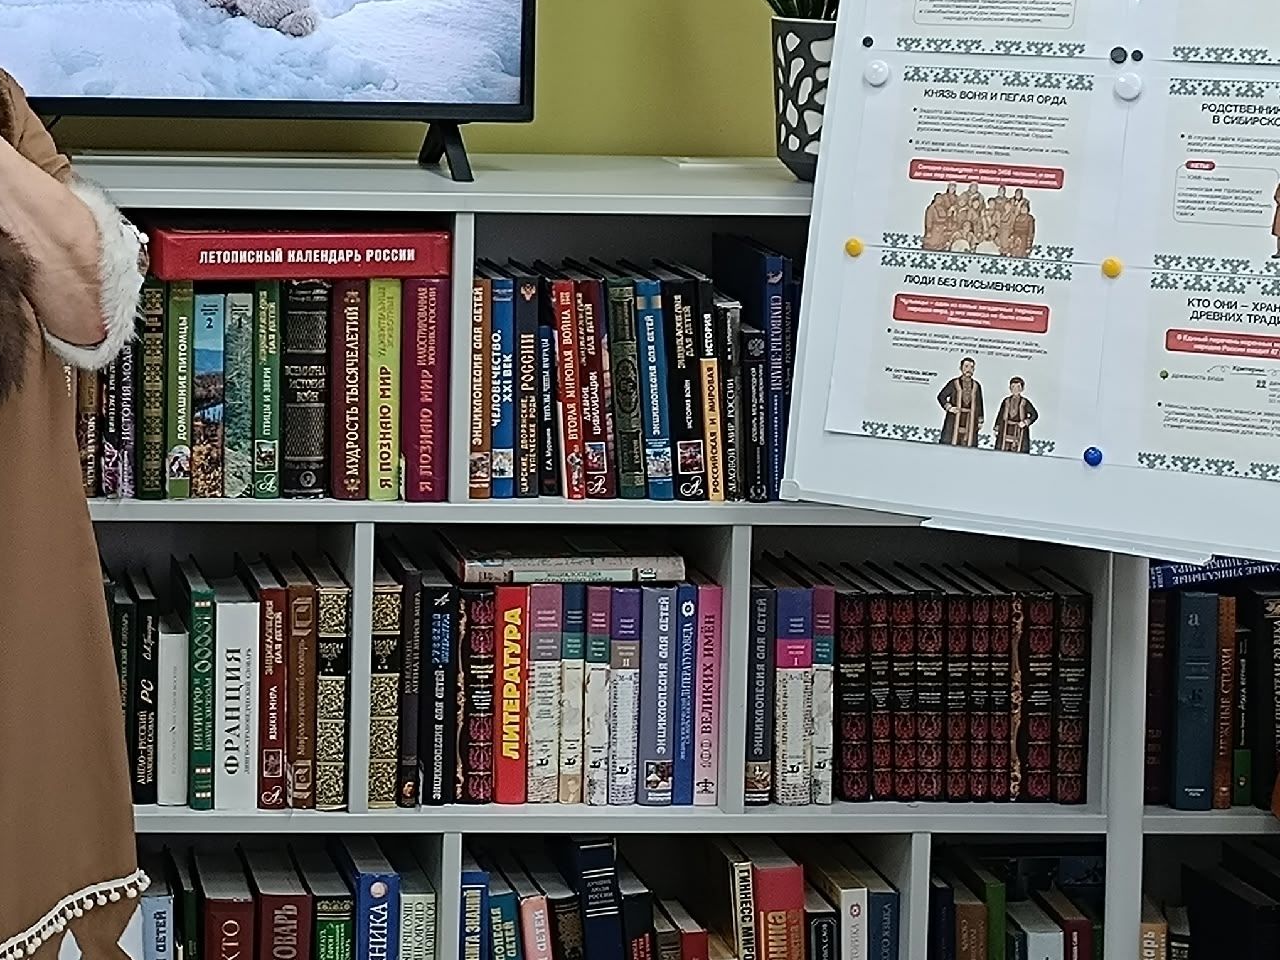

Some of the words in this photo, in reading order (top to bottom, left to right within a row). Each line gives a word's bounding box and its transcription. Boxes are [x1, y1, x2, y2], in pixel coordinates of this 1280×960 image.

[924, 89, 957, 99] КНЯЗЬ
[960, 92, 987, 100] ВОНЯ
[1000, 94, 1033, 103] ПЕГАЯ
[1037, 95, 1067, 105] ОРДА
[1212, 116, 1220, 124] В
[200, 248, 282, 264] ЛЕТОПИСНЫЙ
[288, 249, 361, 265] КАЛЕНДАРЬ
[366, 249, 416, 262] РОССИИ
[904, 274, 935, 285] ЛЮДИ
[938, 277, 956, 286] БЕЗ
[959, 279, 1045, 294] ПИСЬМЕННОСТИ
[1188, 298, 1210, 308] КТО
[1213, 300, 1237, 309] ОНИ
[206, 318, 214, 328] 2
[428, 287, 436, 325] РОССИИ
[472, 287, 484, 322] ДЕТЕЙ
[1190, 311, 1242, 322] ДРЕВНИХ
[177, 317, 189, 372] ПИТОМЦЫ
[428, 327, 436, 366] ХРОНИКА
[560, 310, 573, 344] ВОЙНА
[703, 313, 714, 356] ИСТОРИЯ
[121, 345, 133, 381] МОДЫ
[344, 306, 360, 403] ТЫСЯЧЕЛЕТИЙ
[503, 354, 513, 377] ВЕК
[521, 334, 535, 391] РОССИИ
[563, 350, 576, 398] МИРОВАЯ
[261, 367, 272, 392] ЗВЕРИ
[379, 366, 392, 399] МИР
[419, 370, 433, 402] МИР
[491, 330, 502, 426] ЧЕЛОВЕЧЕСТВО.
[706, 366, 716, 412] МИРОВАЯ
[726, 378, 735, 417] РОССИИ
[121, 385, 132, 440] ИСТОРИЯ
[177, 375, 188, 440] ДОМАШНИЕ
[472, 354, 484, 445] ЭНЦИКЛОПЕДИЯ
[528, 395, 537, 418] РОДЫ
[261, 404, 272, 435] ПТИЦЫ
[379, 405, 394, 471] ПОЗНАЮ
[566, 403, 578, 440] ВТОРАЯ
[727, 422, 735, 443] МИР
[345, 407, 361, 475] МУДРОСТЬ
[418, 408, 433, 476] ПОЗНАЮ
[528, 423, 537, 473] КУПЕЧЕСКИЕ
[709, 431, 720, 494] РОССИЙСКАЯ
[727, 448, 737, 492] ДЕЛОВОЙ
[380, 478, 392, 489] Я
[419, 481, 432, 492] Я
[1172, 568, 1243, 585] УНИКАЛЬНЫЕ
[657, 596, 669, 631] ДЕТЕЙ
[755, 598, 767, 633] ДЕТЕЙ
[699, 614, 716, 658] ИМЁН
[296, 639, 308, 675] словарь
[1221, 648, 1232, 693] СТИХИ
[268, 686, 277, 710] МИРА
[502, 607, 522, 760] ЛИТЕРАТУРА
[700, 664, 713, 734] ВЕЛИКИХ
[223, 647, 243, 775] ФРАНЦИЯ
[268, 713, 277, 740] ЯЗЫКИ
[656, 662, 668, 754] ЭНЦИКЛОПЕДИЯ
[753, 664, 765, 755] ЭНЦИКЛОПЕДИЯ
[464, 889, 481, 932] ЗНАНИЙ
[738, 869, 753, 922] ГИННЕСС
[154, 911, 167, 952] ДЕТЕЙ
[533, 909, 545, 951] ДЕТЕЙ
[882, 903, 891, 937] ЯЗЫКА
